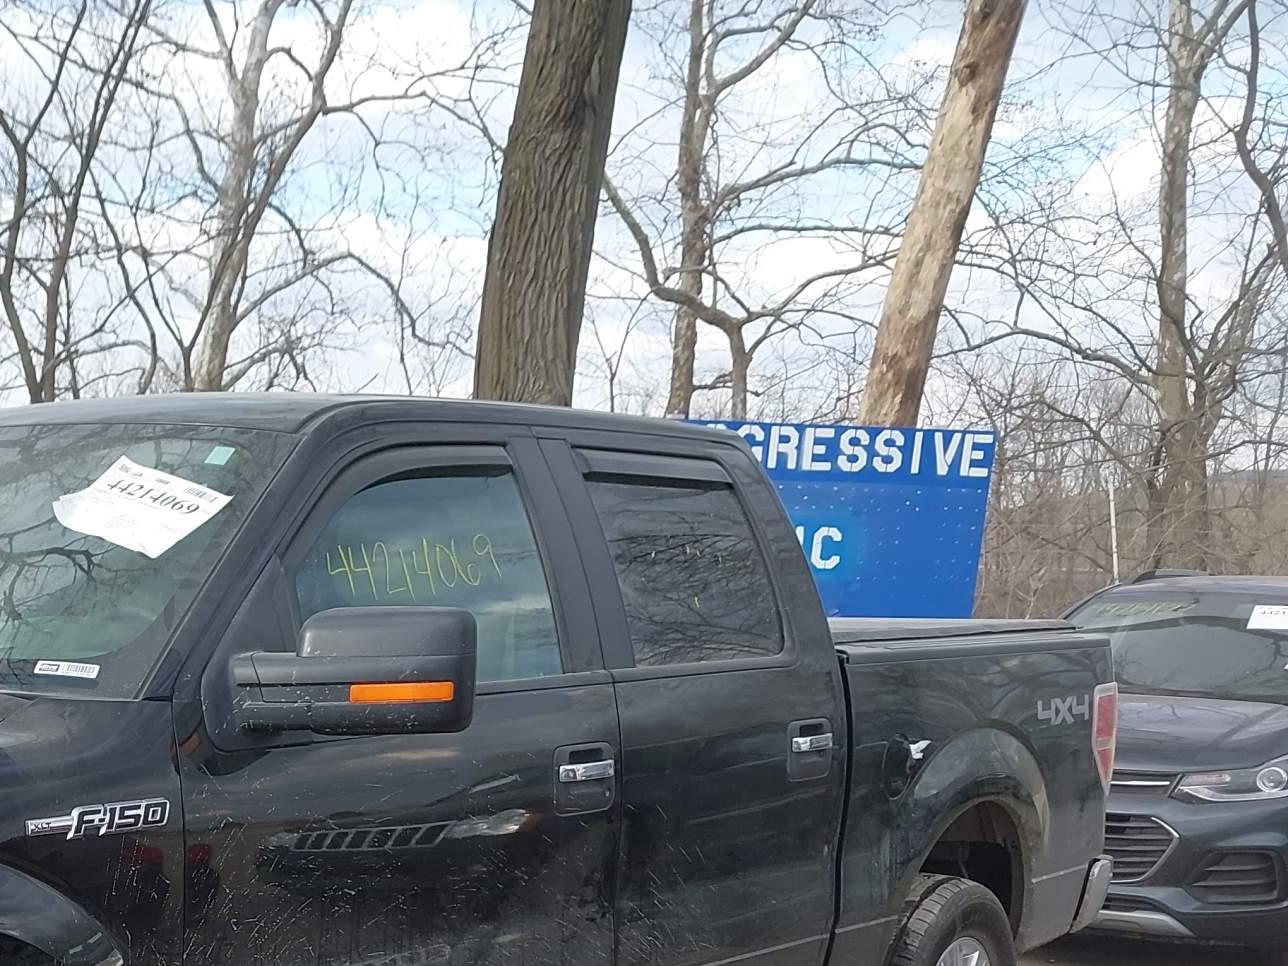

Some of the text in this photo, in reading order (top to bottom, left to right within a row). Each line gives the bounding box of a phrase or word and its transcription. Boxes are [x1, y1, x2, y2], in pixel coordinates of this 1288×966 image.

[707, 423, 994, 478] GRESSIVE
[106, 479, 200, 515] 44214069
[325, 533, 503, 601] 44214069
[32, 797, 170, 841] XLT F-150
